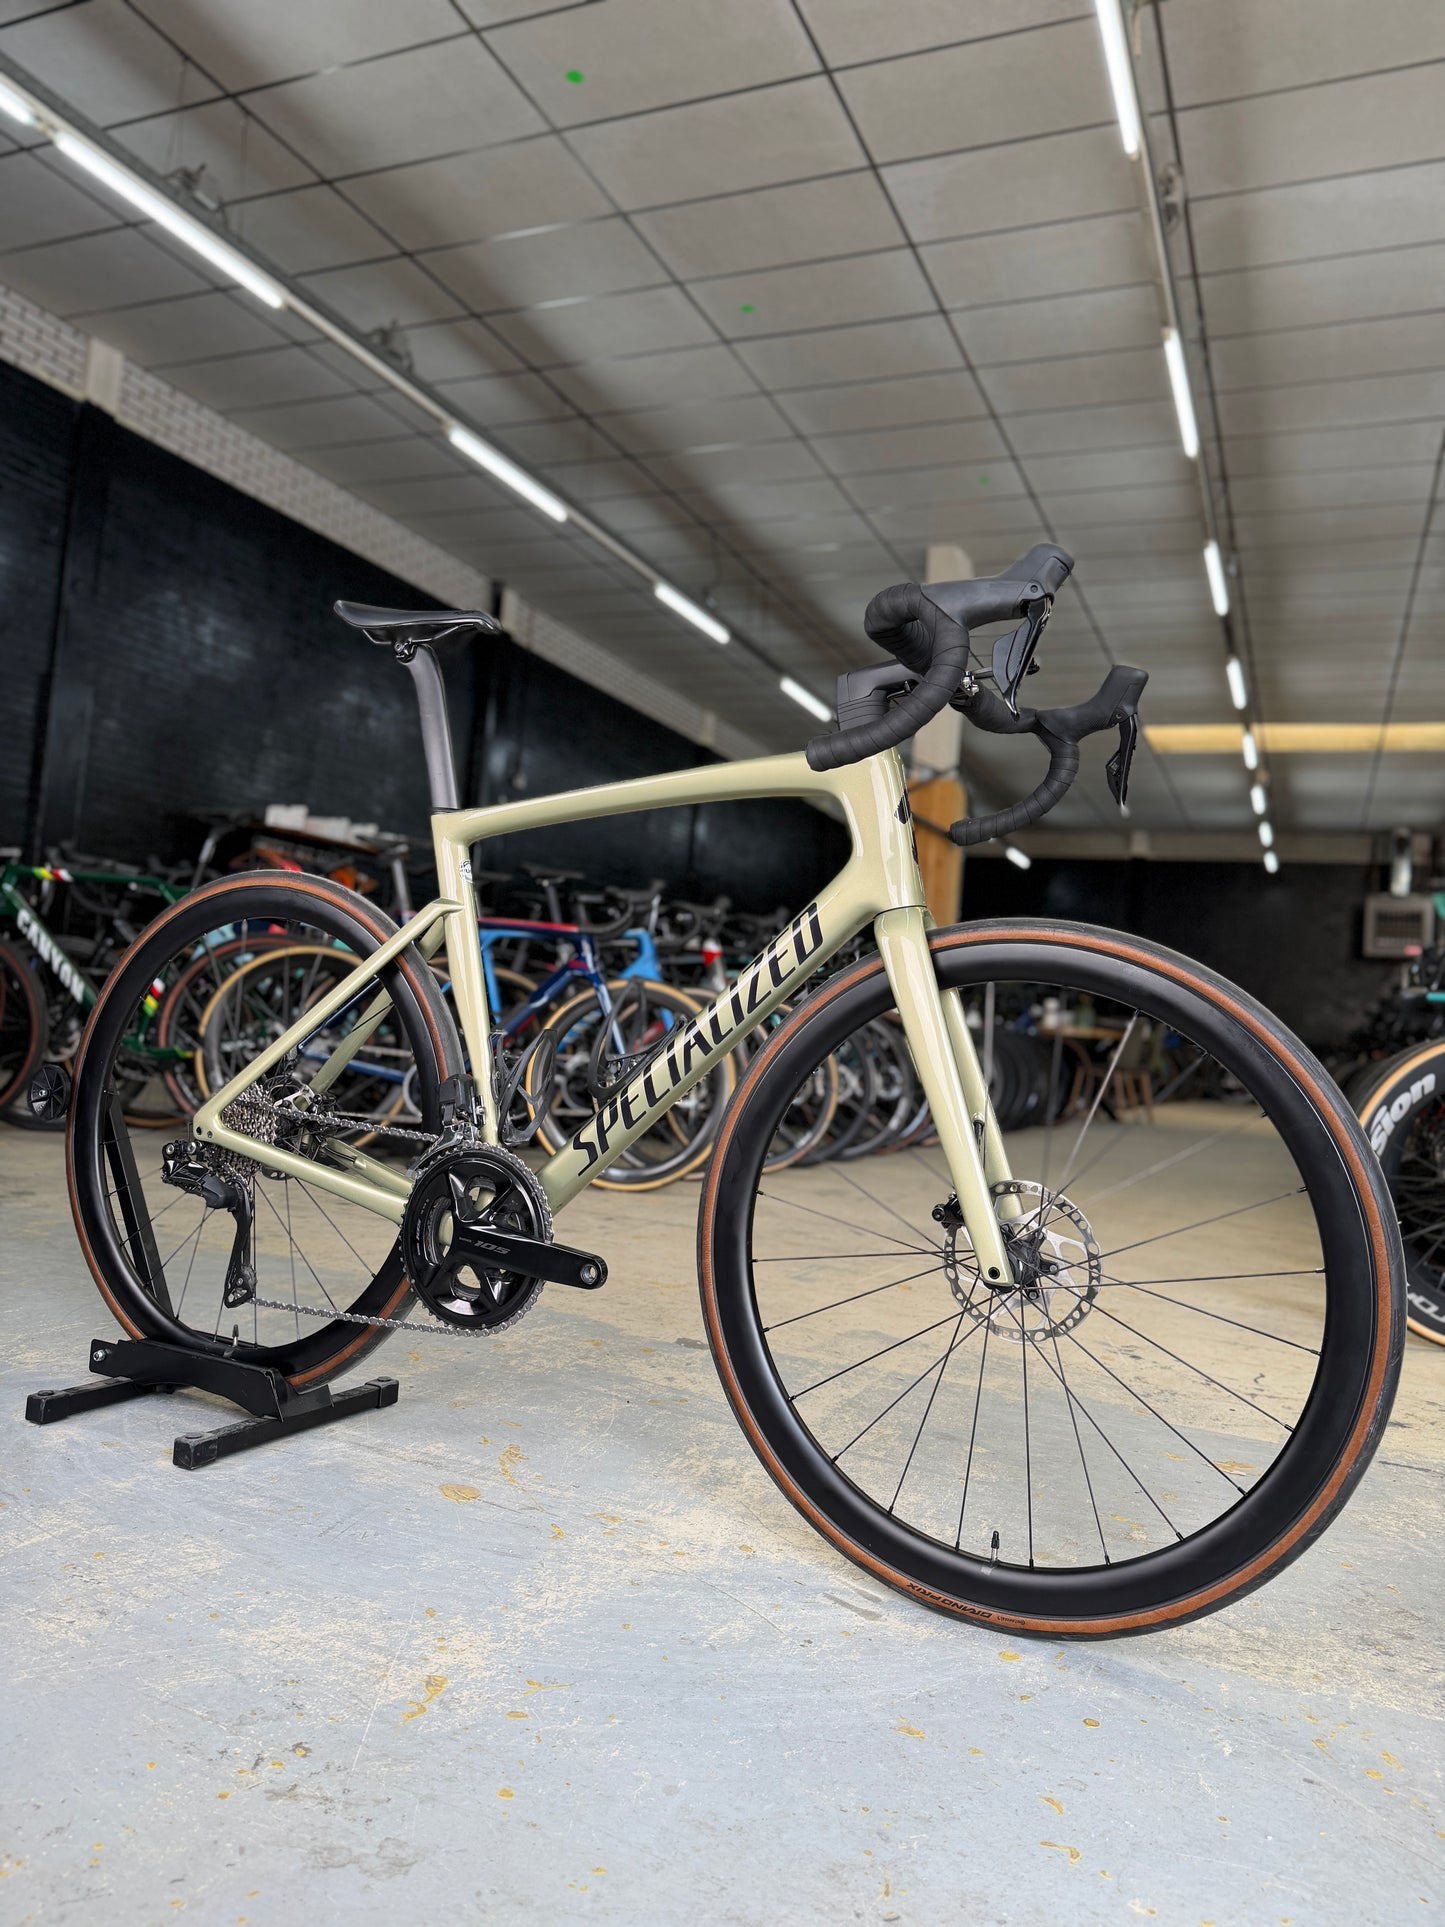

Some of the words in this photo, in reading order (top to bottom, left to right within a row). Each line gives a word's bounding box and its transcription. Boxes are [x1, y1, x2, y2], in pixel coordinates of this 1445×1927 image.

[17, 909, 85, 1004] CANYON
[573, 902, 824, 1177] SPECIALIZED
[474, 1240, 511, 1255] 105
[906, 1582, 942, 1601] PRIX
[941, 1598, 993, 1619] GRAND
